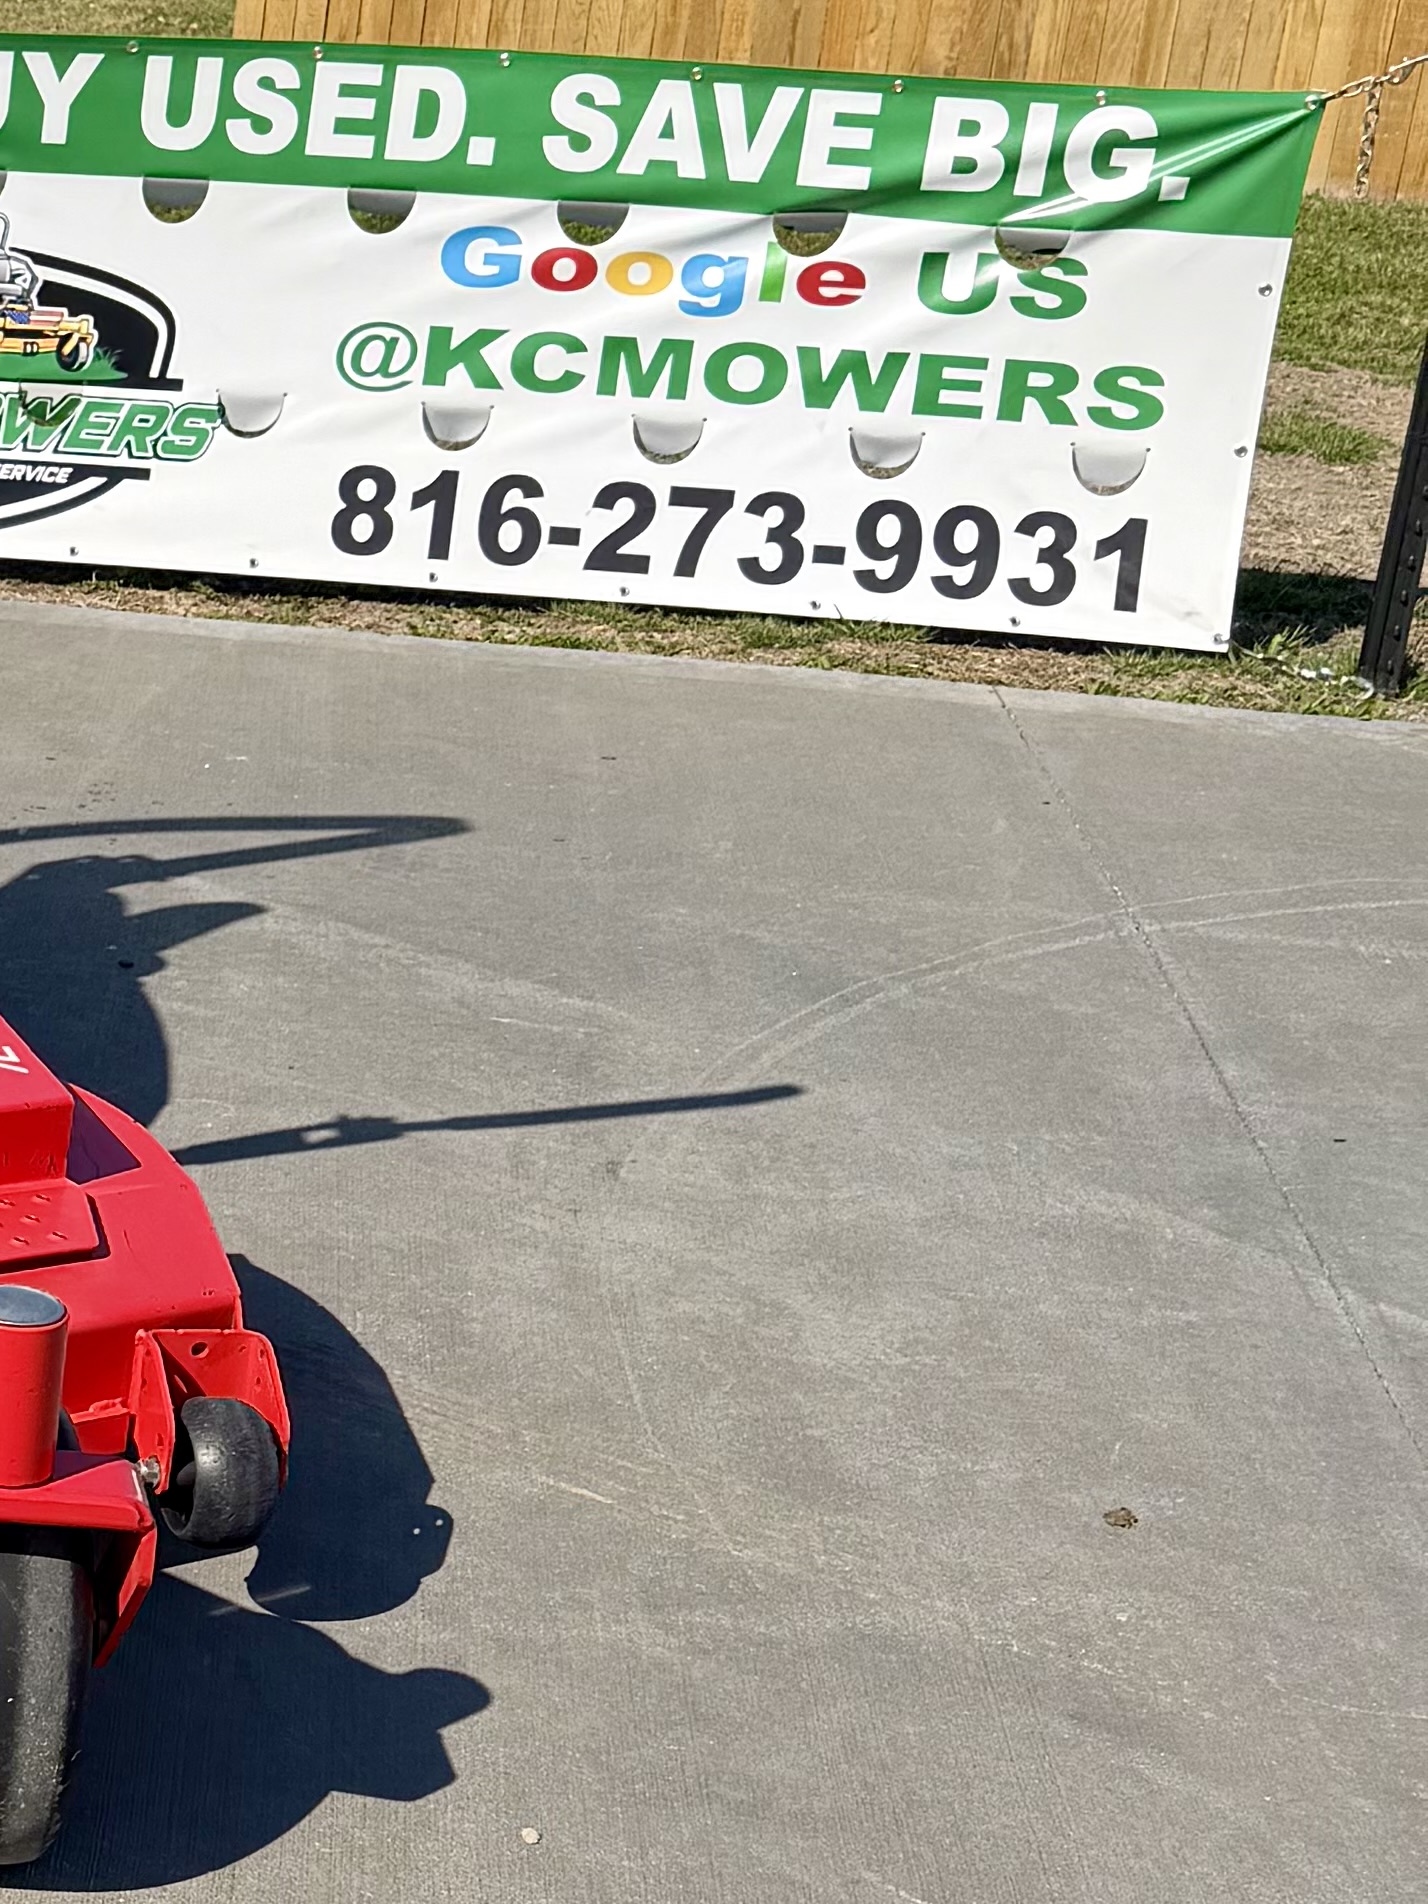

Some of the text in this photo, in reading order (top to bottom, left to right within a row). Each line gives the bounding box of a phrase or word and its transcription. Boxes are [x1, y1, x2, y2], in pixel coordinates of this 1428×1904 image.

[141, 55, 496, 166] USED.
[542, 72, 883, 191] SAVE
[920, 95, 1191, 203] BIG.
[439, 224, 1090, 320] Google US
[335, 320, 1166, 431] @KCMOWERS
[330, 463, 1149, 613] 816-273-9931
